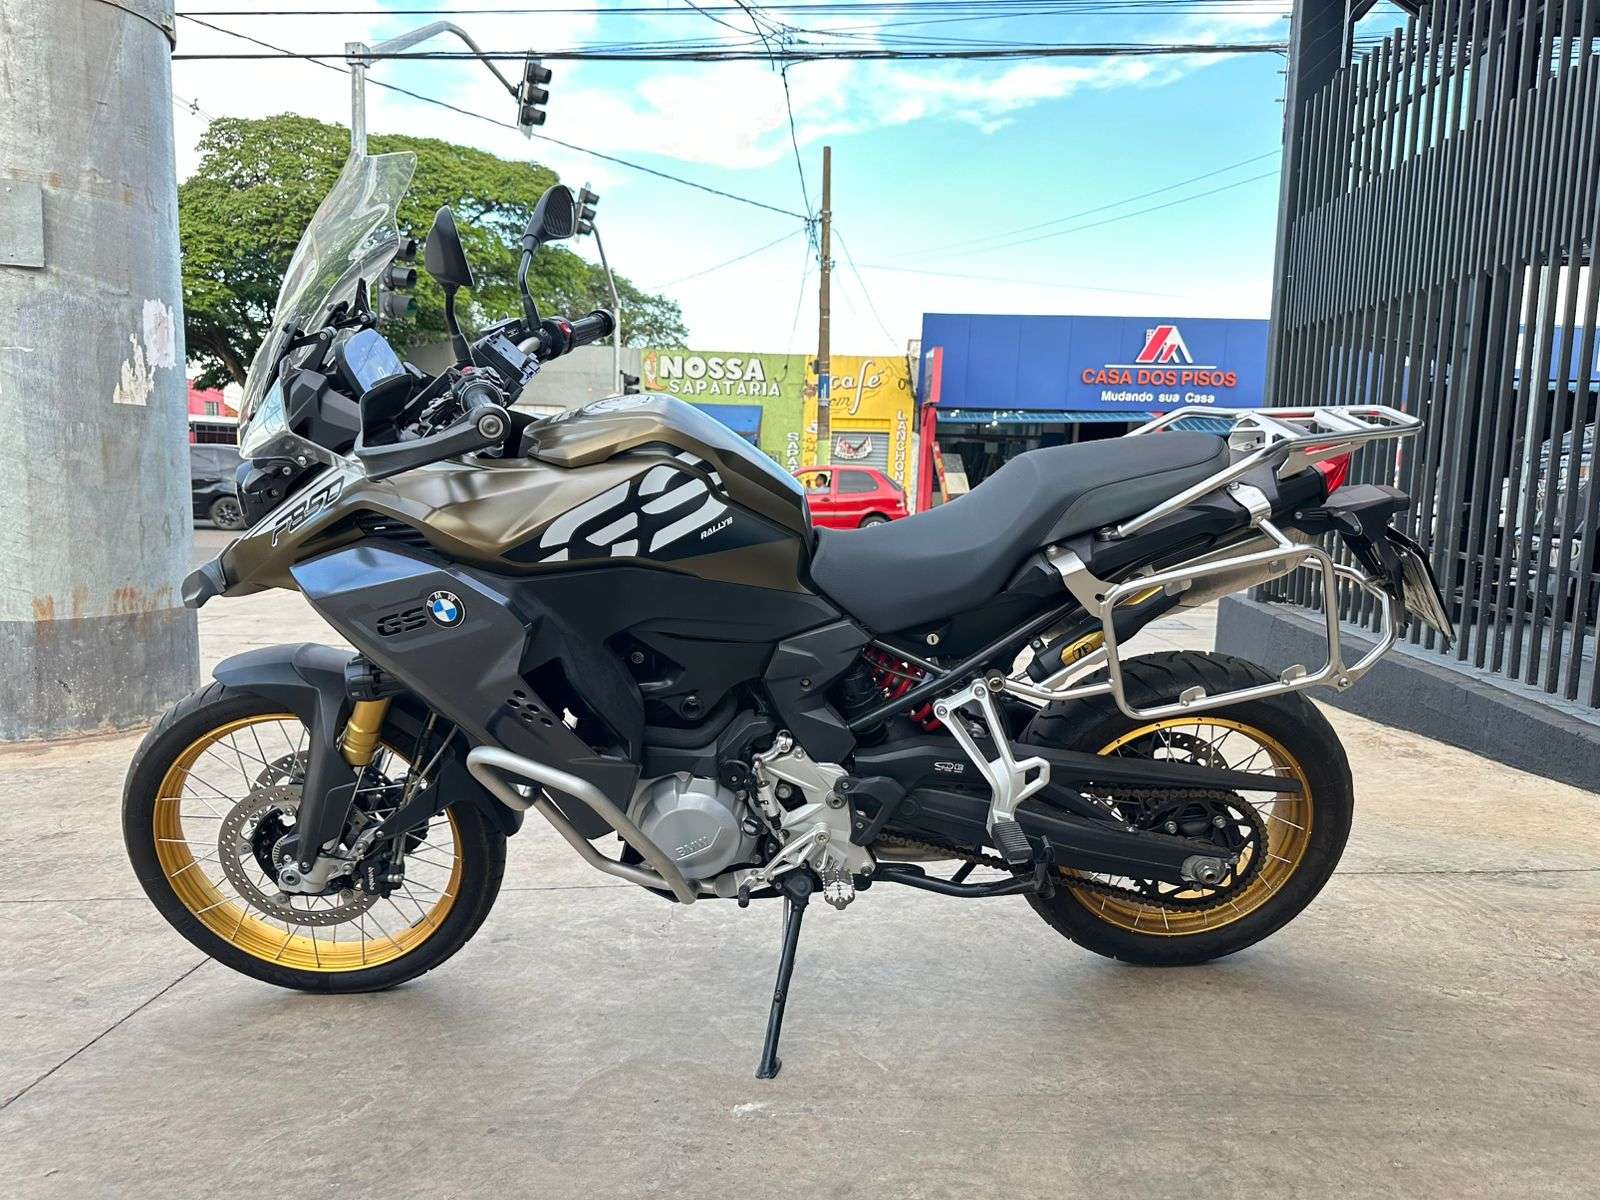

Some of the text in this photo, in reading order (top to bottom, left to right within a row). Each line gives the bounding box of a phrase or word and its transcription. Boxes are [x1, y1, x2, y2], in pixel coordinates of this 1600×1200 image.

[660, 355, 766, 382] NOSSA
[1082, 368, 1237, 387] CASA DOS PISOS
[669, 380, 781, 397] SAPATARIA
[830, 360, 885, 415] café
[1100, 390, 1215, 404] Mudando sua Casa
[271, 474, 345, 547] F850
[376, 606, 428, 637] GS
